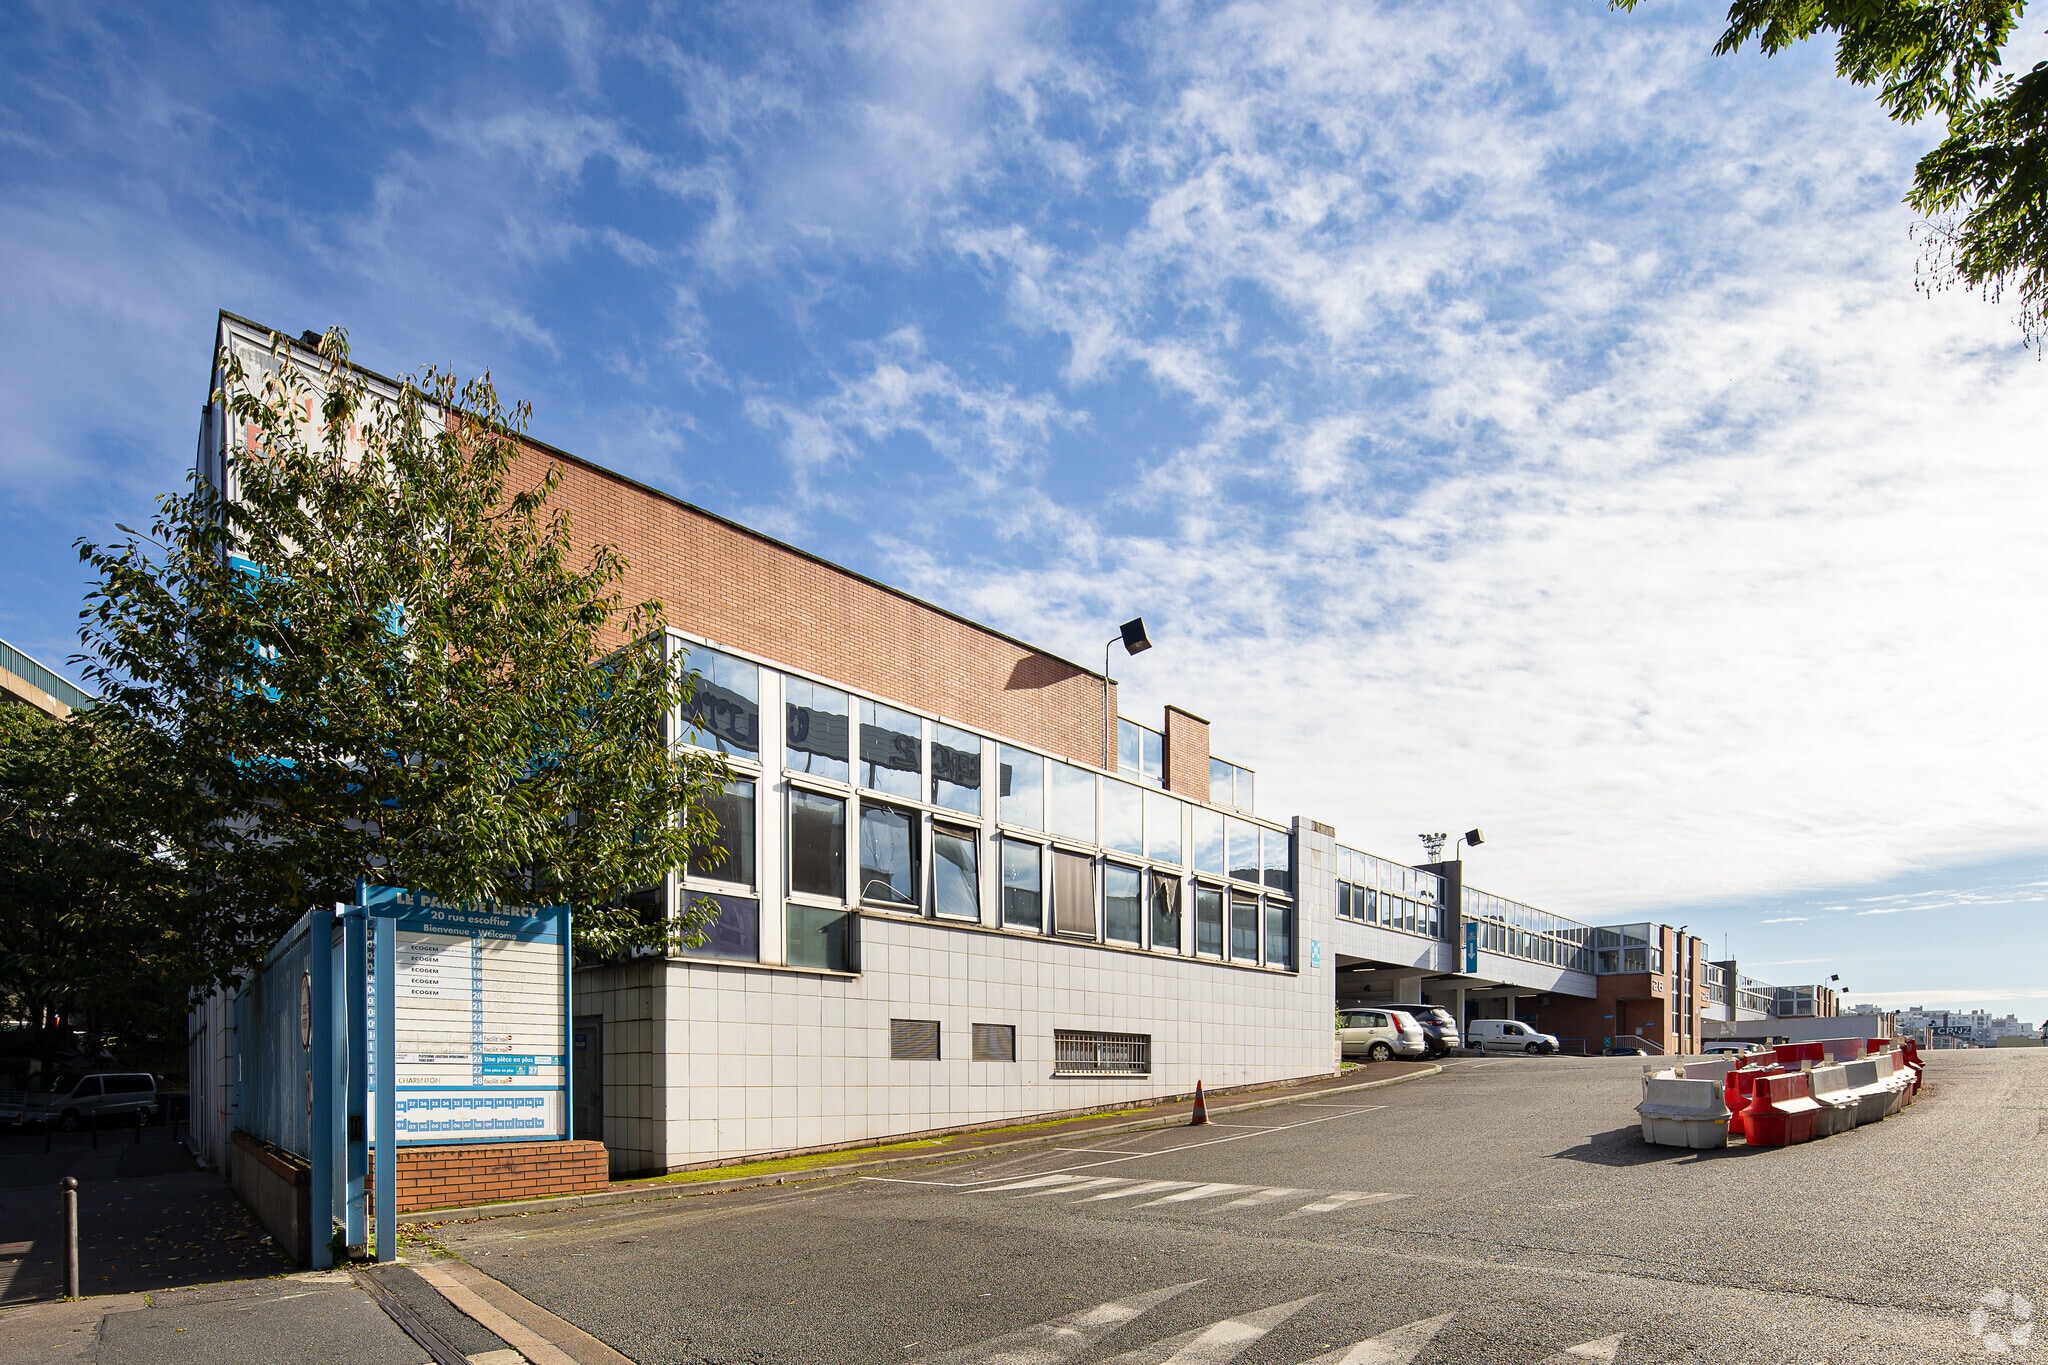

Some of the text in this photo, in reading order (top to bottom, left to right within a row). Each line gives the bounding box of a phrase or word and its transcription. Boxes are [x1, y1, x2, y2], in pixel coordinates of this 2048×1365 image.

[397, 892, 414, 905] LE
[467, 899, 487, 913] DE
[493, 903, 539, 918] BERCY
[431, 911, 510, 927] 20 rue escoffier
[424, 924, 470, 936] Bienvenue
[478, 929, 517, 940] Welcome
[472, 939, 482, 947] 15
[1652, 980, 1664, 992] 26
[472, 1002, 482, 1010] 21
[497, 1056, 512, 1064] pièce
[522, 1056, 534, 1064] plus
